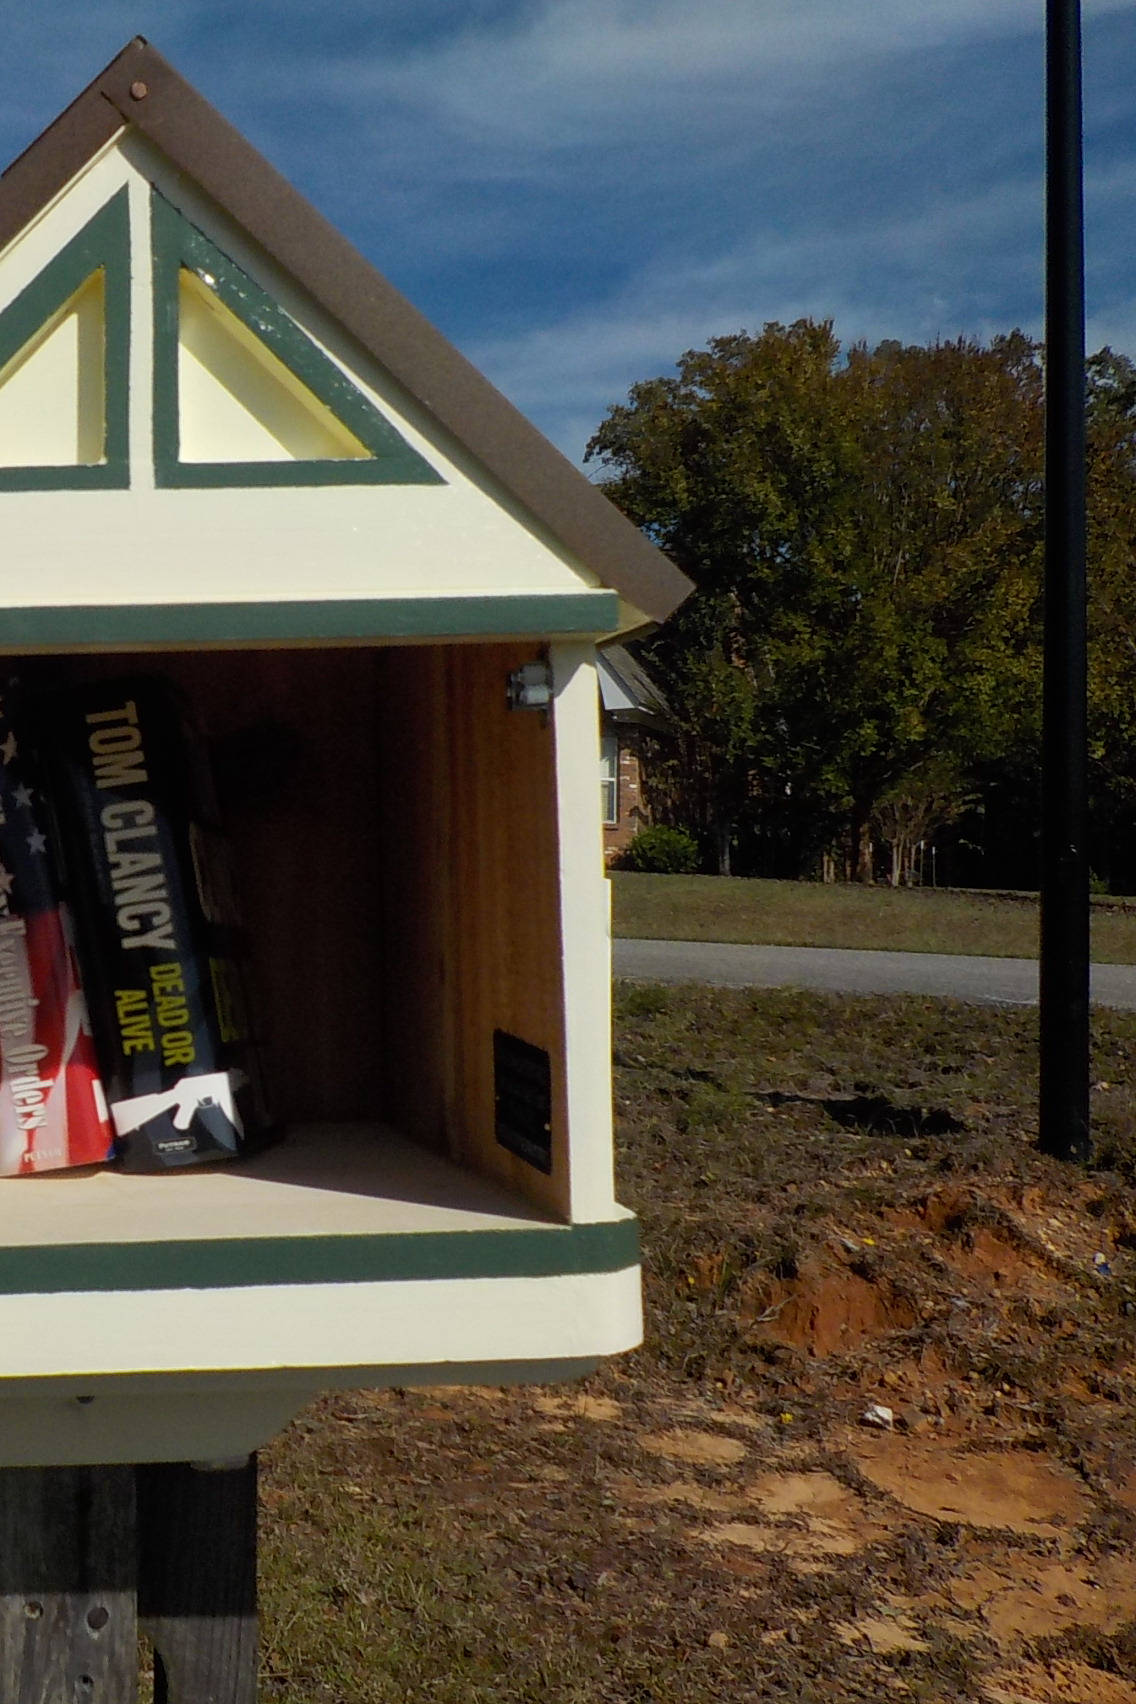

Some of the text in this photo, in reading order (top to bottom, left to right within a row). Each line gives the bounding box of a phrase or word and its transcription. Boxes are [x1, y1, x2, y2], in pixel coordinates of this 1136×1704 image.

[85, 700, 177, 949] TOM CLANCY
[114, 990, 156, 1056] ALIVE
[149, 962, 196, 1067] DEAD OR
[5, 1044, 55, 1131] Orders
